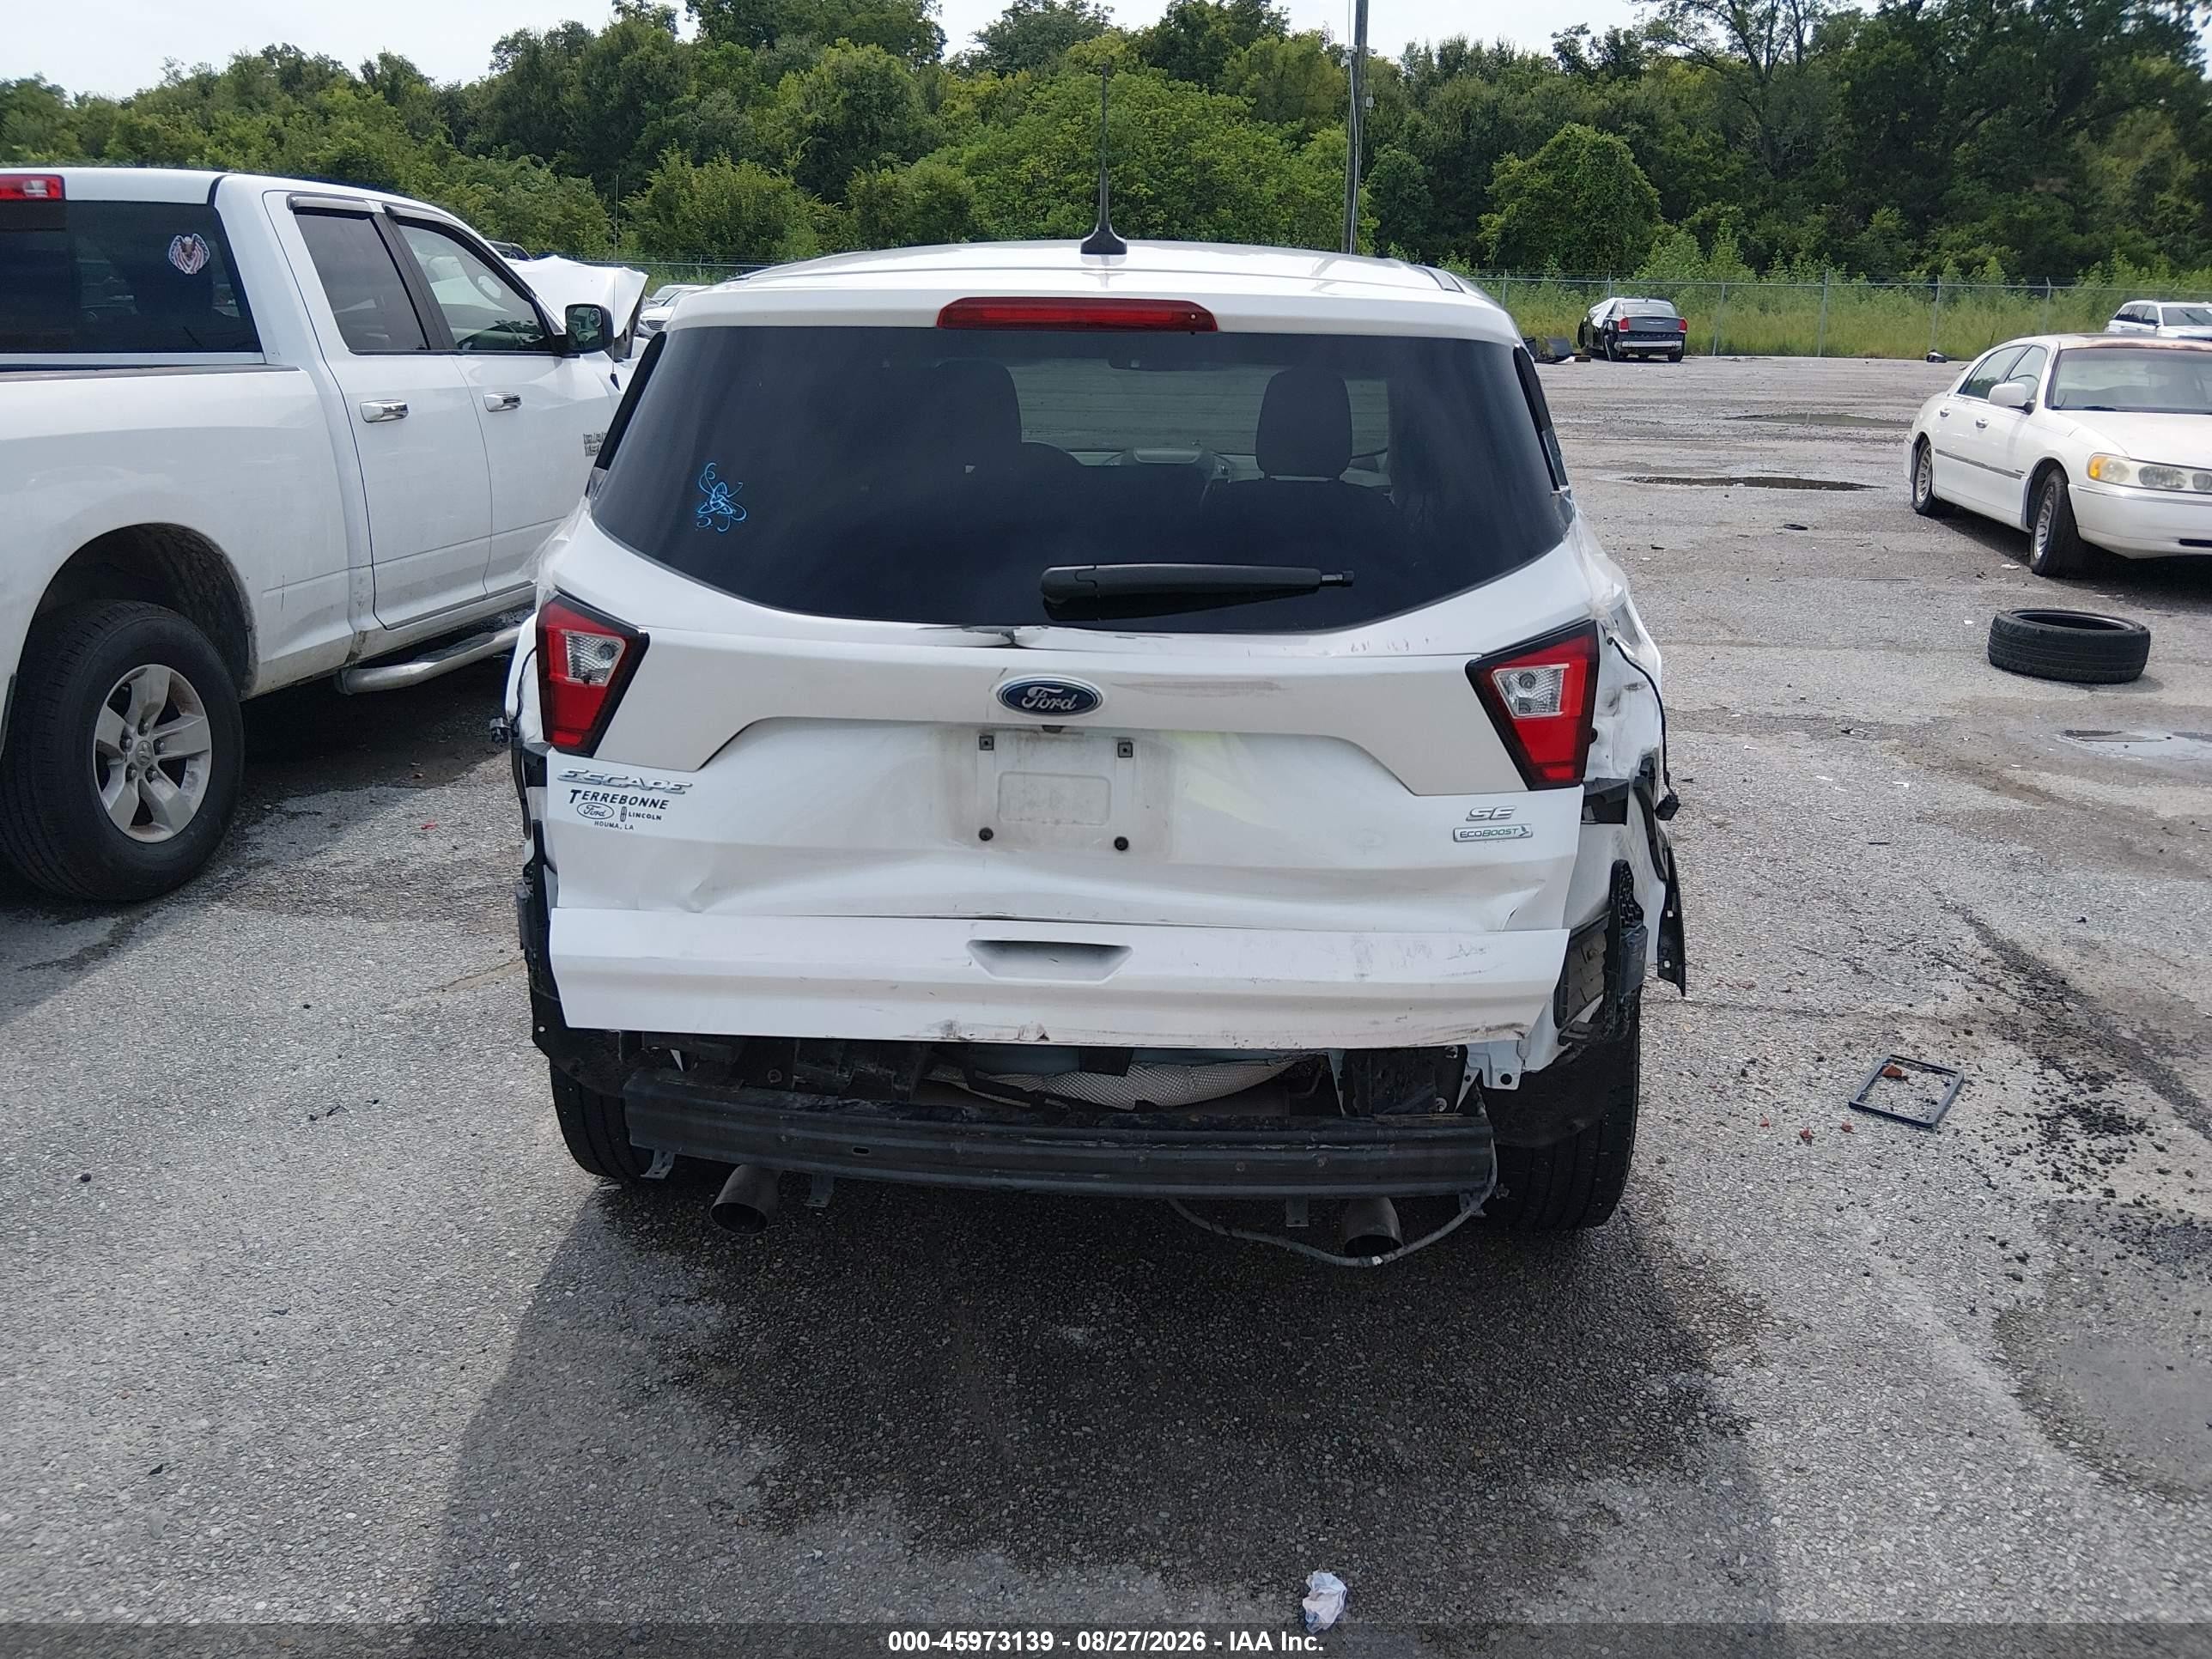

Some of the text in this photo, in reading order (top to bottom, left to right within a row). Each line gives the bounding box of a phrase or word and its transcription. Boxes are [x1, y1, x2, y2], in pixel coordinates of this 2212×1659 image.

[1022, 686, 1078, 710] Ford
[557, 768, 693, 795] ESCAPE
[569, 789, 669, 810] TERREBONNE
[583, 804, 662, 821] Ford LINCOLN
[1465, 805, 1517, 821] SE
[594, 820, 623, 830] HOUMA,
